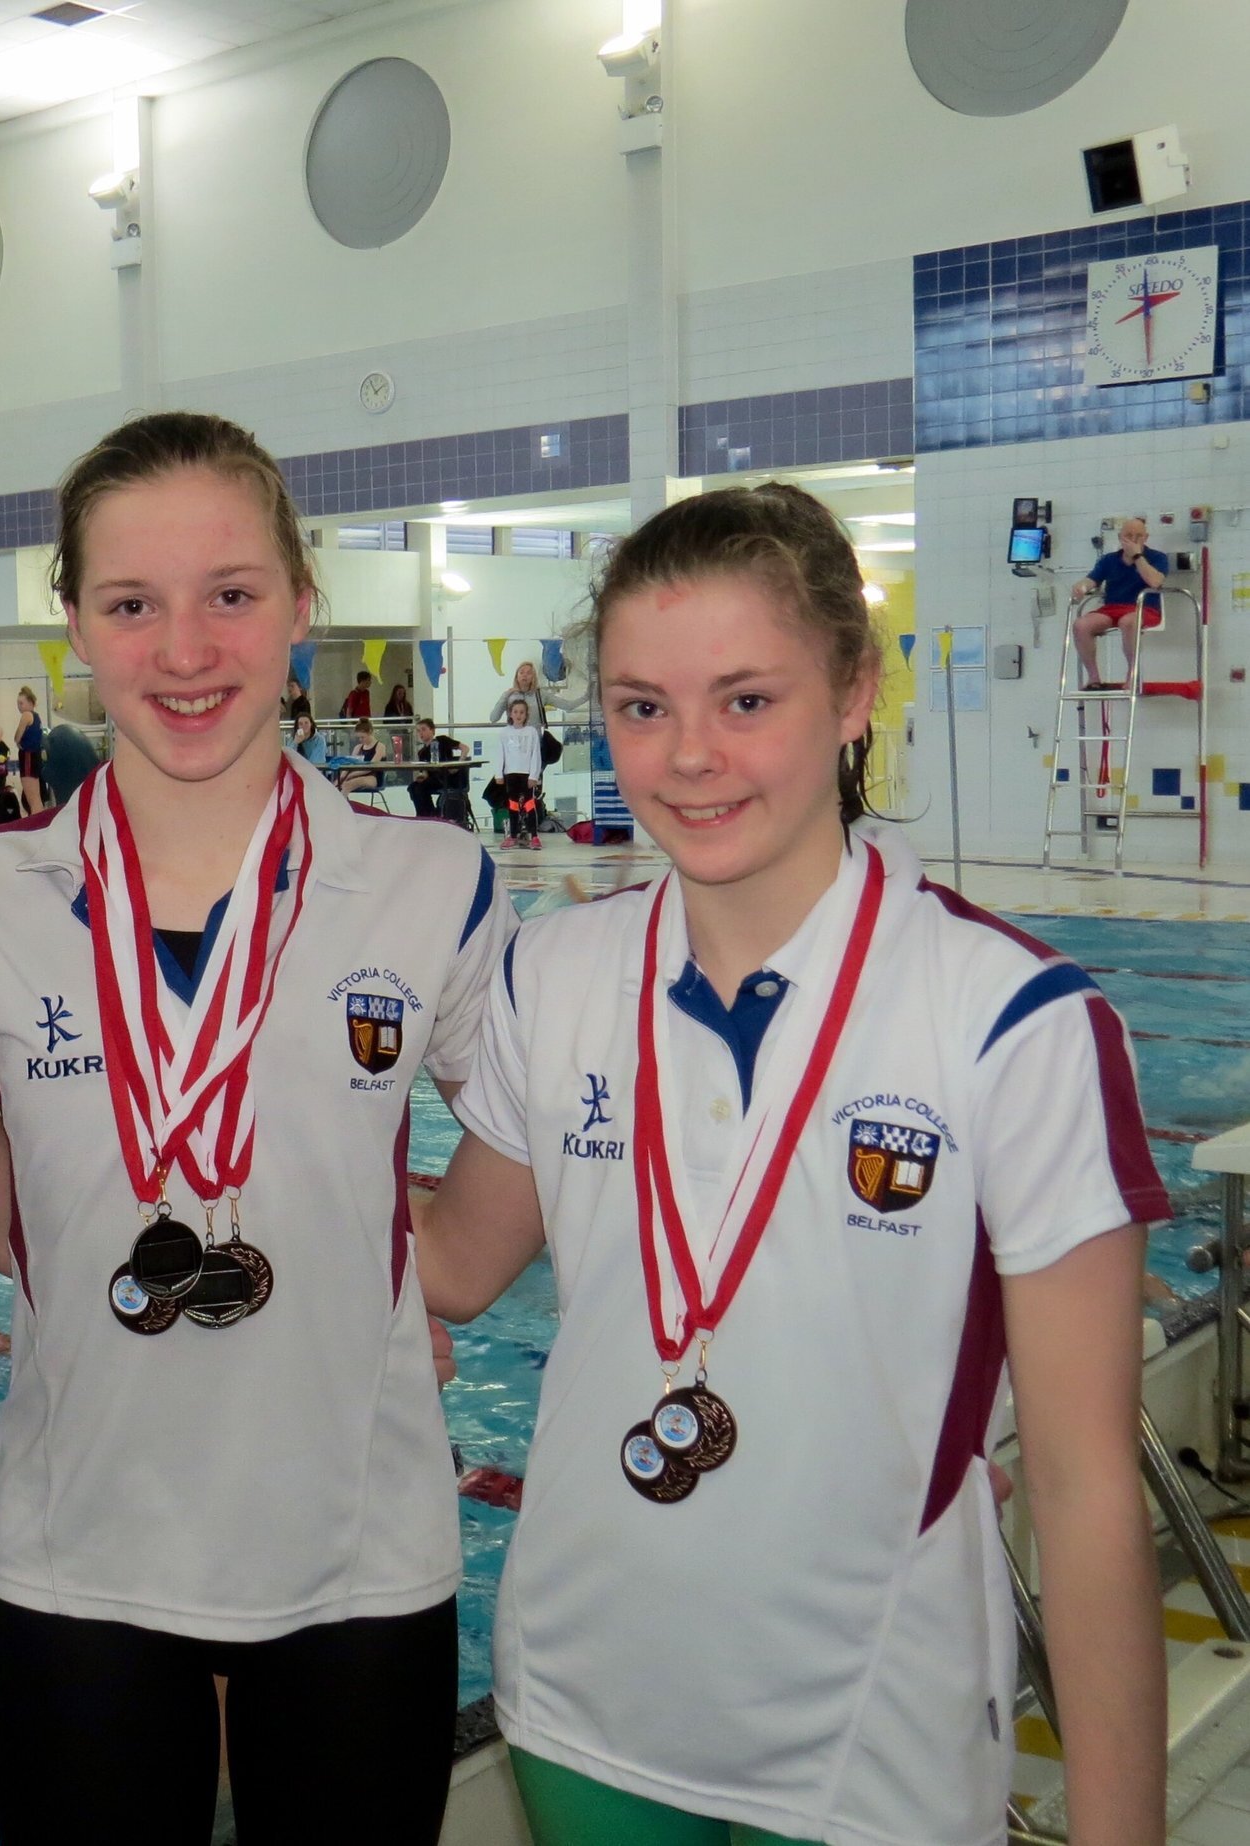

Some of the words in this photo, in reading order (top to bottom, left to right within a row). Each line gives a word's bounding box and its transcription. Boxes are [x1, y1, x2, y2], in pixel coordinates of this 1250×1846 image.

[1127, 278, 1184, 297] SPEDO
[326, 966, 381, 1003] VICTORIA
[383, 969, 424, 1014] COLLEGE
[27, 1055, 105, 1080] KUKR
[350, 1078, 396, 1091] BELFAST
[831, 1093, 901, 1126] VICTORIA
[904, 1097, 960, 1154] COLLEGE
[562, 1132, 625, 1160] KUKRI
[846, 1213, 923, 1237] BELFAST
